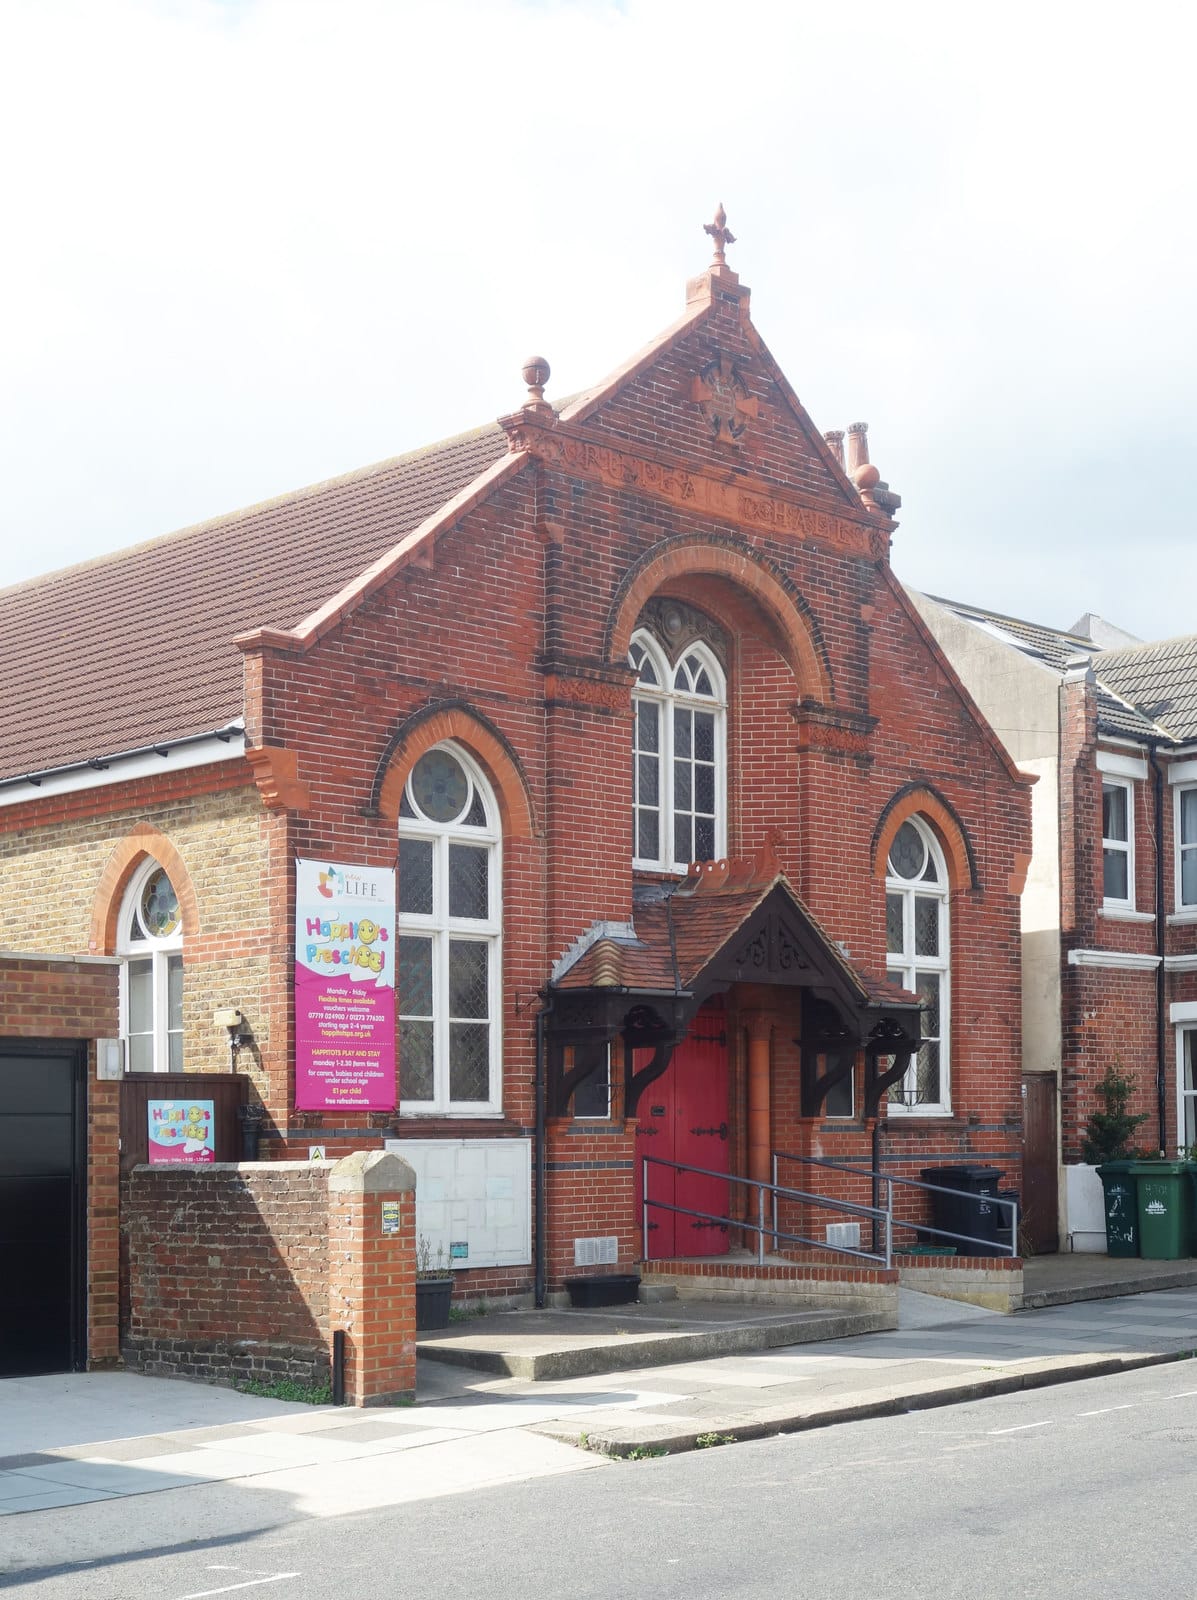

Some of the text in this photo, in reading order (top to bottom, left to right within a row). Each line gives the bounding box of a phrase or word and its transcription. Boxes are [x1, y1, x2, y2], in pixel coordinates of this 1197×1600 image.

[346, 881, 377, 896] LIFE
[306, 917, 388, 944] Happitots
[306, 944, 385, 972] Preschool
[327, 988, 348, 996] Monday
